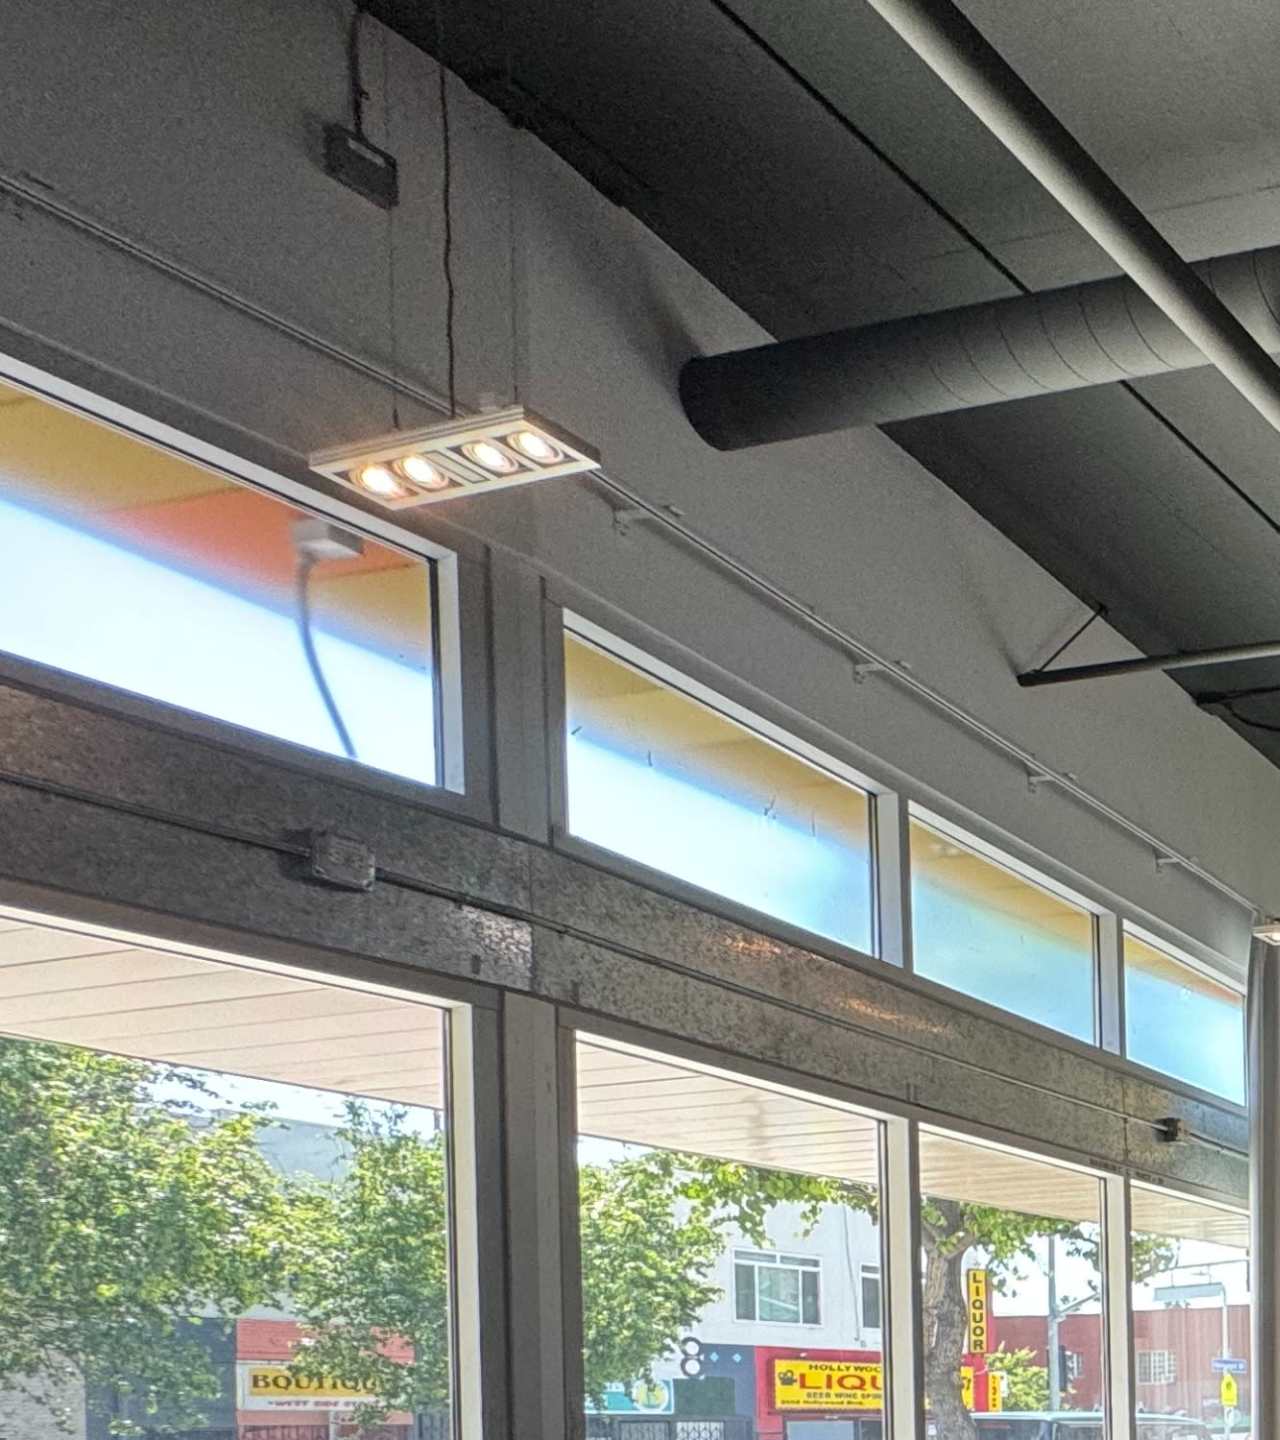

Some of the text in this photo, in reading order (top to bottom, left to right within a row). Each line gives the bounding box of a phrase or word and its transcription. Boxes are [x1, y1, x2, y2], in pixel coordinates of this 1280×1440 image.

[972, 1272, 984, 1351] LIQUOR
[808, 1363, 881, 1373] HOLLYWOO
[798, 1372, 882, 1391] LIQU
